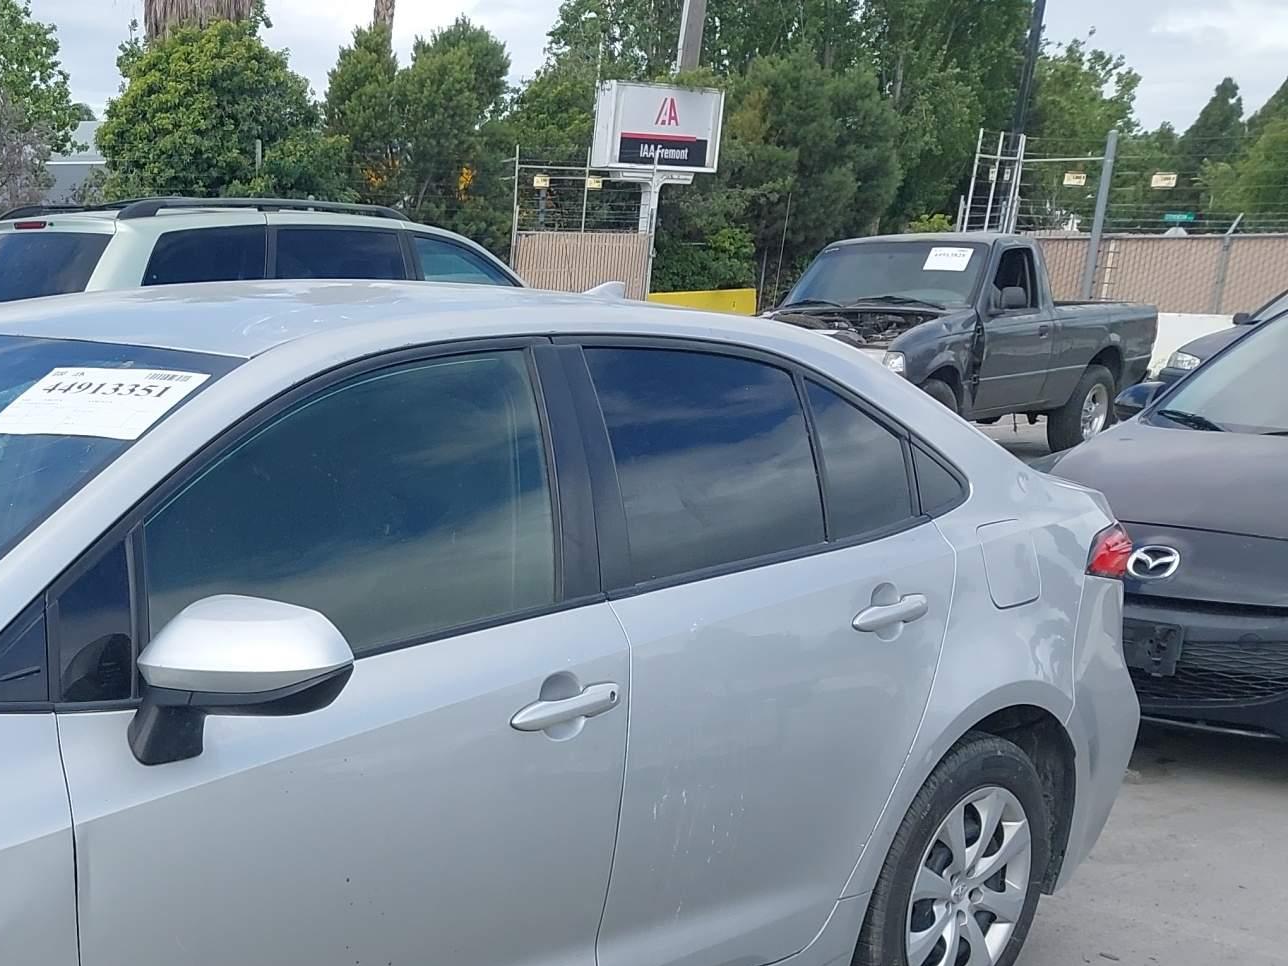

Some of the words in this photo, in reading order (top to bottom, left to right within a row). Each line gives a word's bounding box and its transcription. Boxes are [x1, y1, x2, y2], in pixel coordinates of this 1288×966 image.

[639, 143, 654, 158] IAA
[656, 145, 689, 161] Fremont
[42, 381, 172, 398] 44913351
